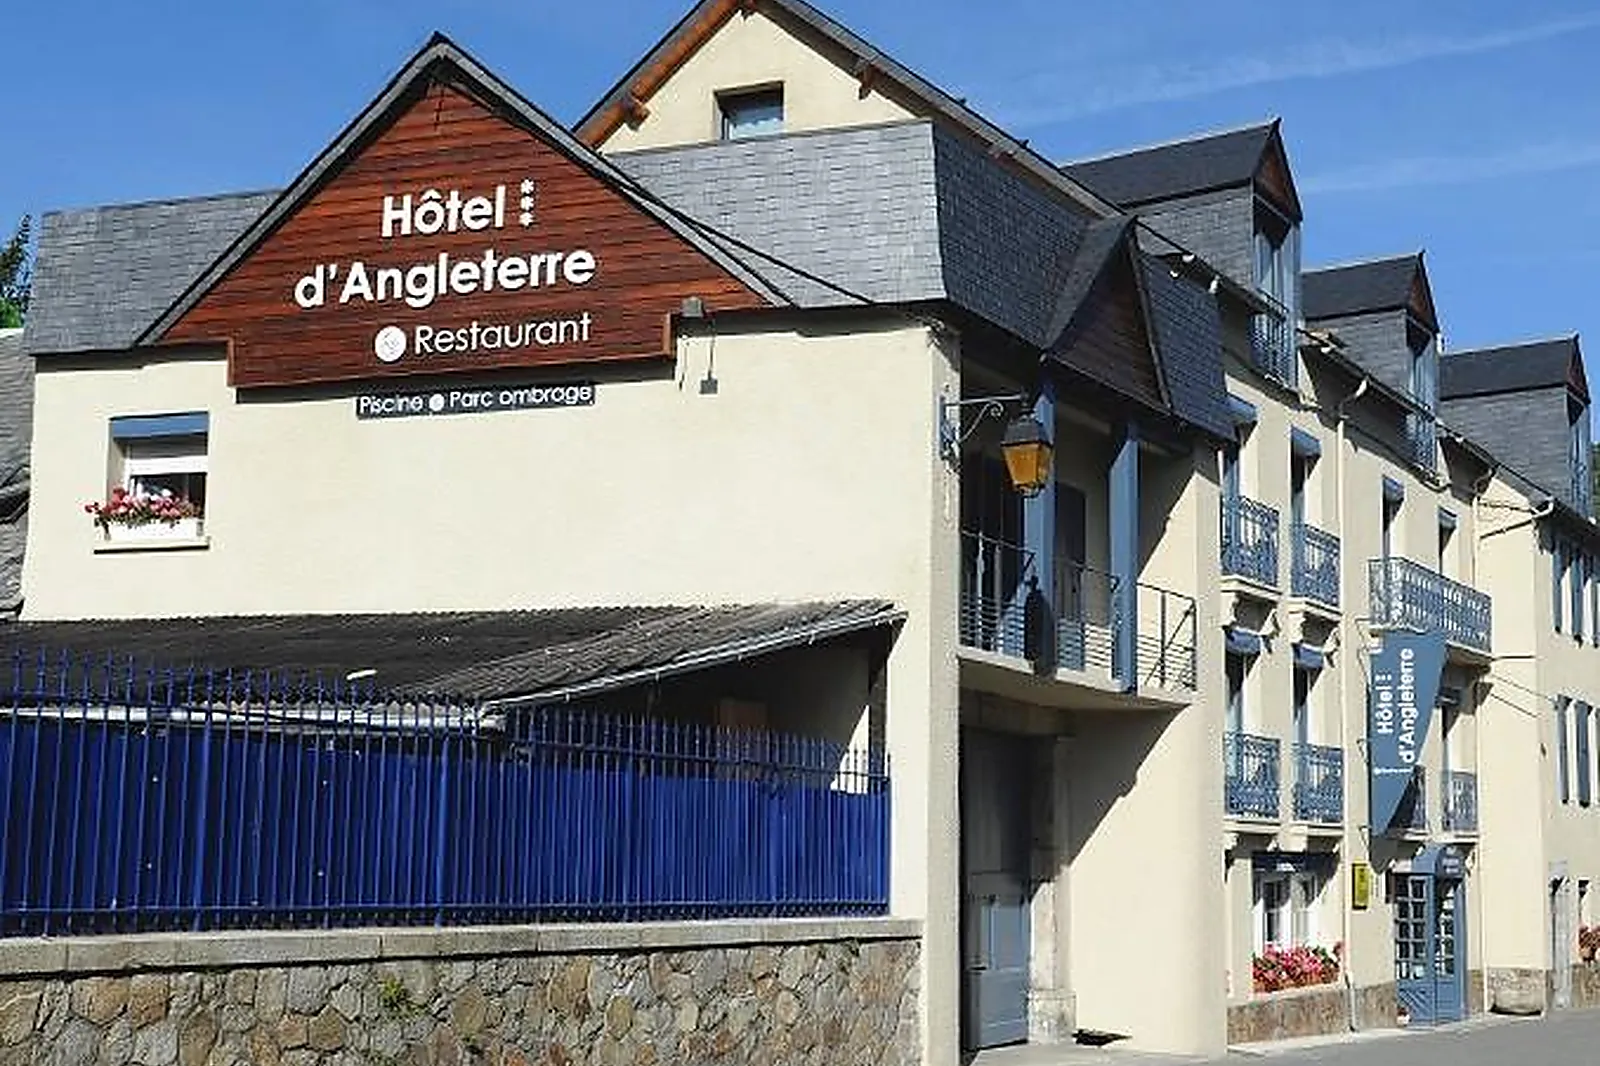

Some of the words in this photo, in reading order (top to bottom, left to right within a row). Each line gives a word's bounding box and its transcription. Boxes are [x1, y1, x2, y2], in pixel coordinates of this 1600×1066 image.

[382, 185, 506, 237] Hôtel
[294, 249, 597, 308] d'Angleterre
[414, 312, 592, 355] Restaurant
[359, 394, 423, 414] Piscine
[450, 390, 493, 408] Parc
